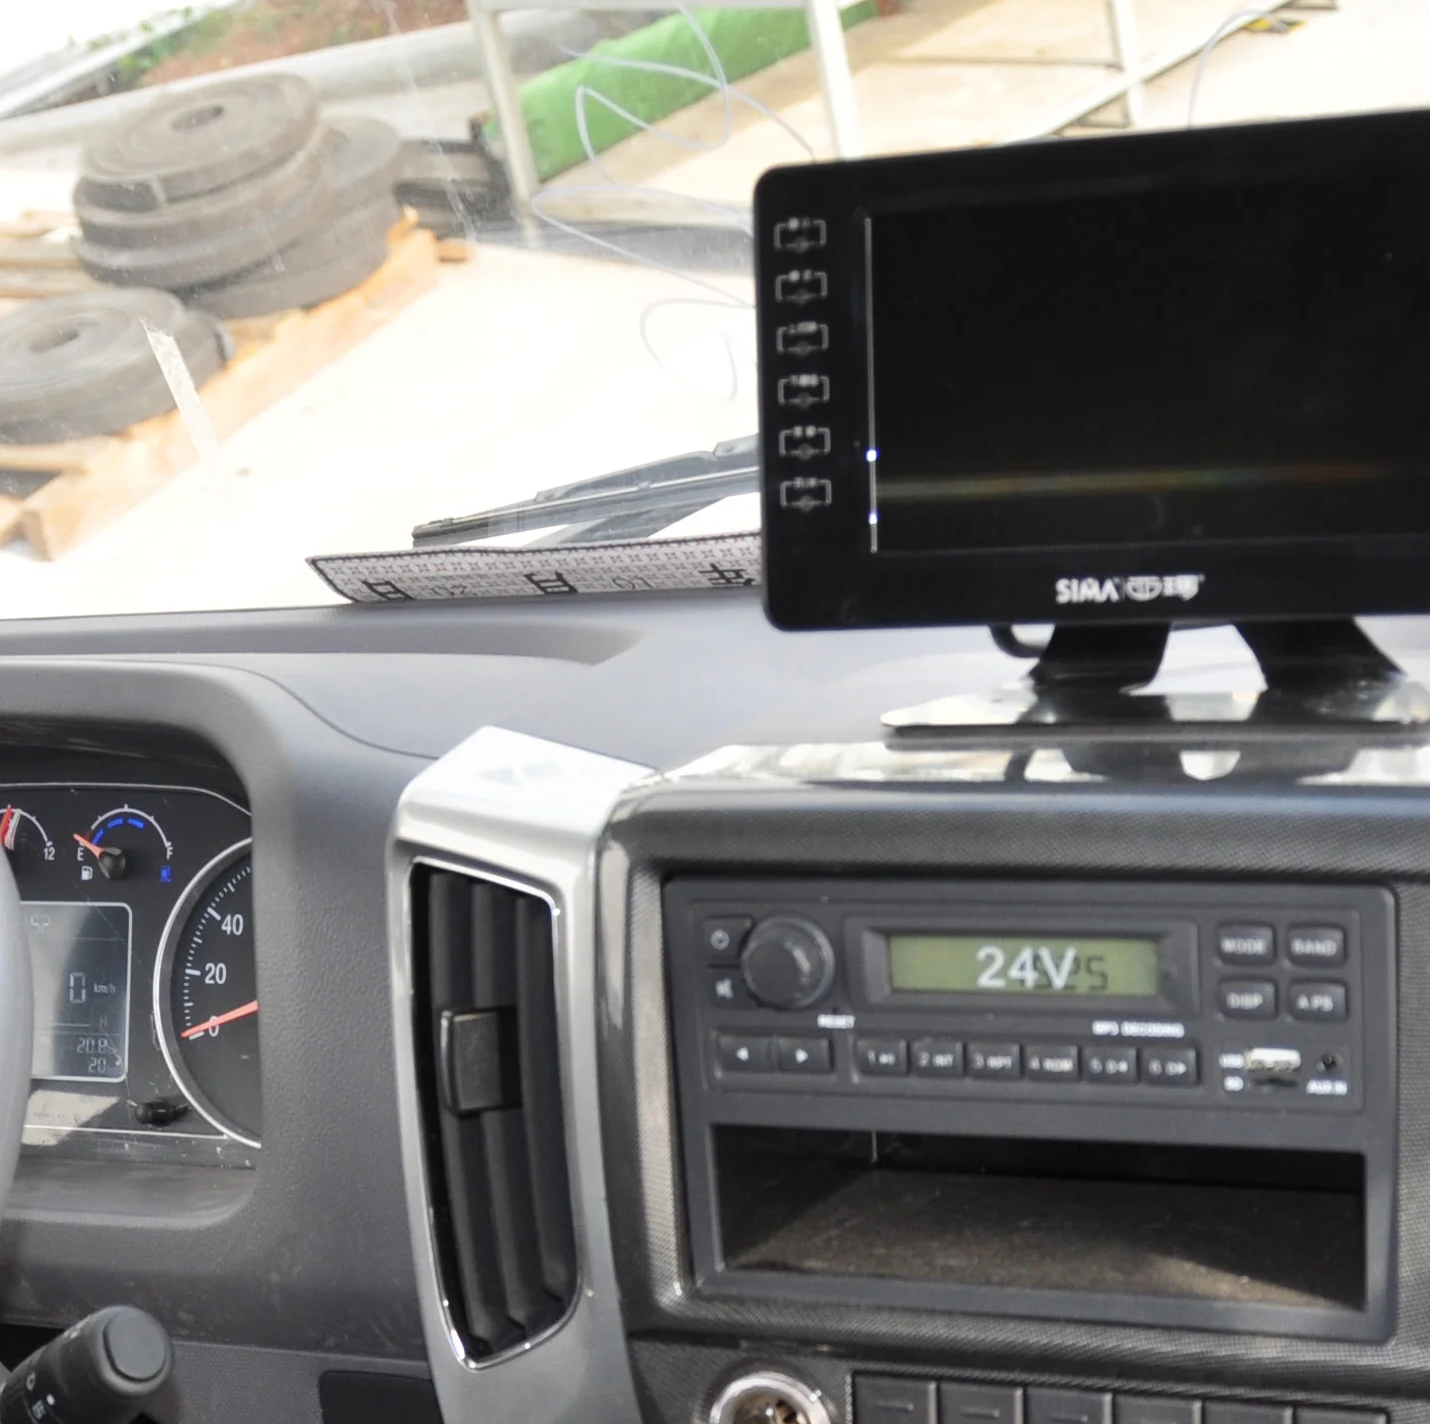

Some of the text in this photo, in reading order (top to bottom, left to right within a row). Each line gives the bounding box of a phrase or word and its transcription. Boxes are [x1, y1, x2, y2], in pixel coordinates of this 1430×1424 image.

[44, 847, 55, 860] 12
[77, 848, 84, 861] E
[166, 846, 173, 860] F
[221, 914, 244, 935] 40
[1222, 937, 1266, 955] MODE
[1290, 938, 1337, 957] BAND
[205, 963, 227, 984] 20
[975, 945, 1077, 989] 24V
[69, 972, 86, 1003] 0
